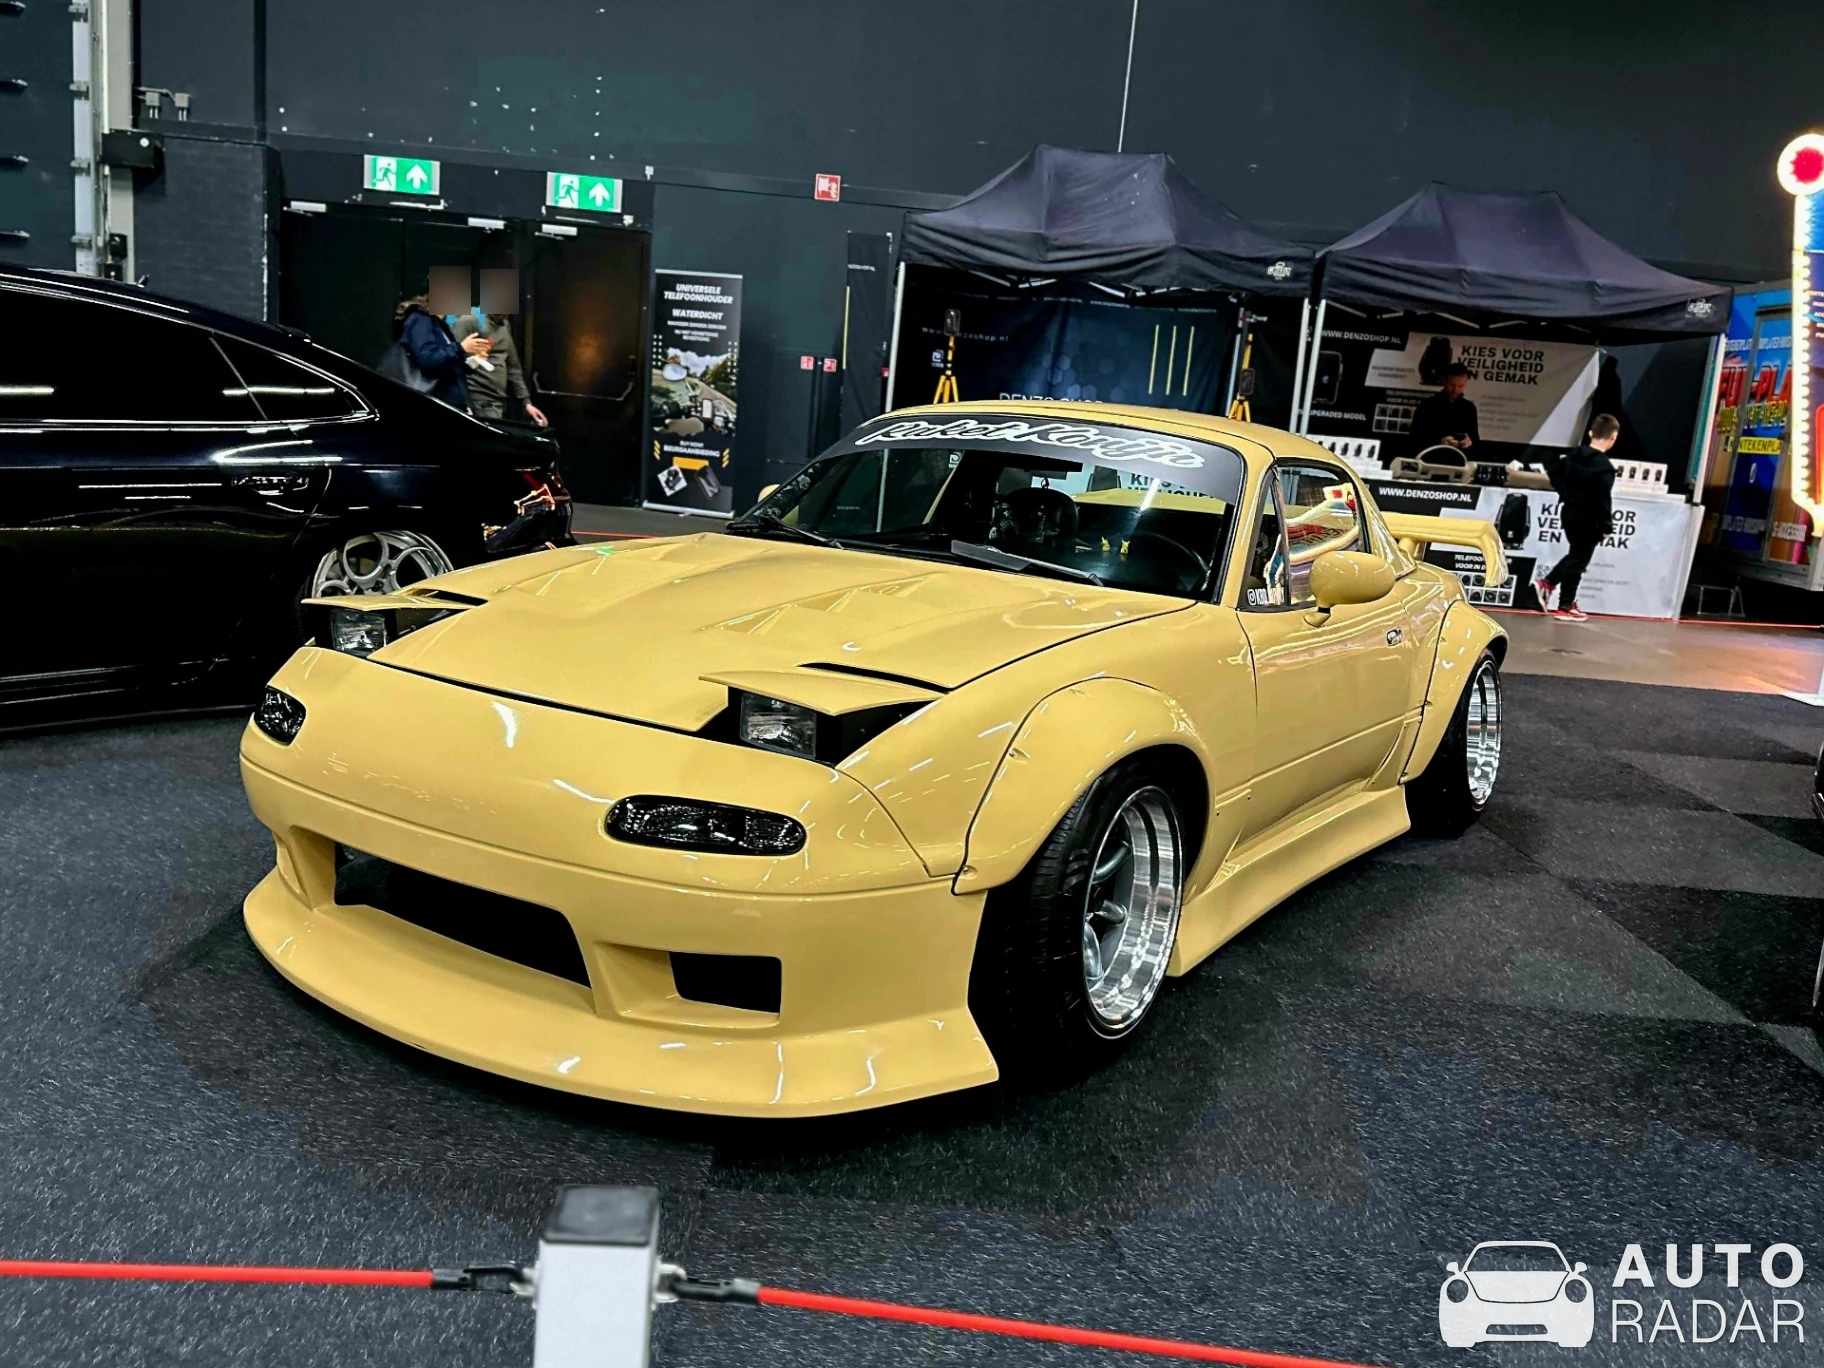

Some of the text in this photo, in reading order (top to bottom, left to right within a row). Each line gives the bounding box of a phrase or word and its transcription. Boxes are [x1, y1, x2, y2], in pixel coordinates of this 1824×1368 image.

[676, 284, 721, 294] UNIVERSELE
[664, 291, 733, 304] TELEFOONHOUDER
[672, 308, 724, 320] WATERDICHT
[1461, 345, 1545, 362] KIES VOOR
[1458, 357, 1544, 373] VEILIGHEID
[1483, 371, 1538, 385] GEMAK
[1343, 412, 1367, 420] MODEL
[1379, 487, 1472, 502] WWW.DENZOSHOP.NL
[1538, 530, 1562, 543] EN
